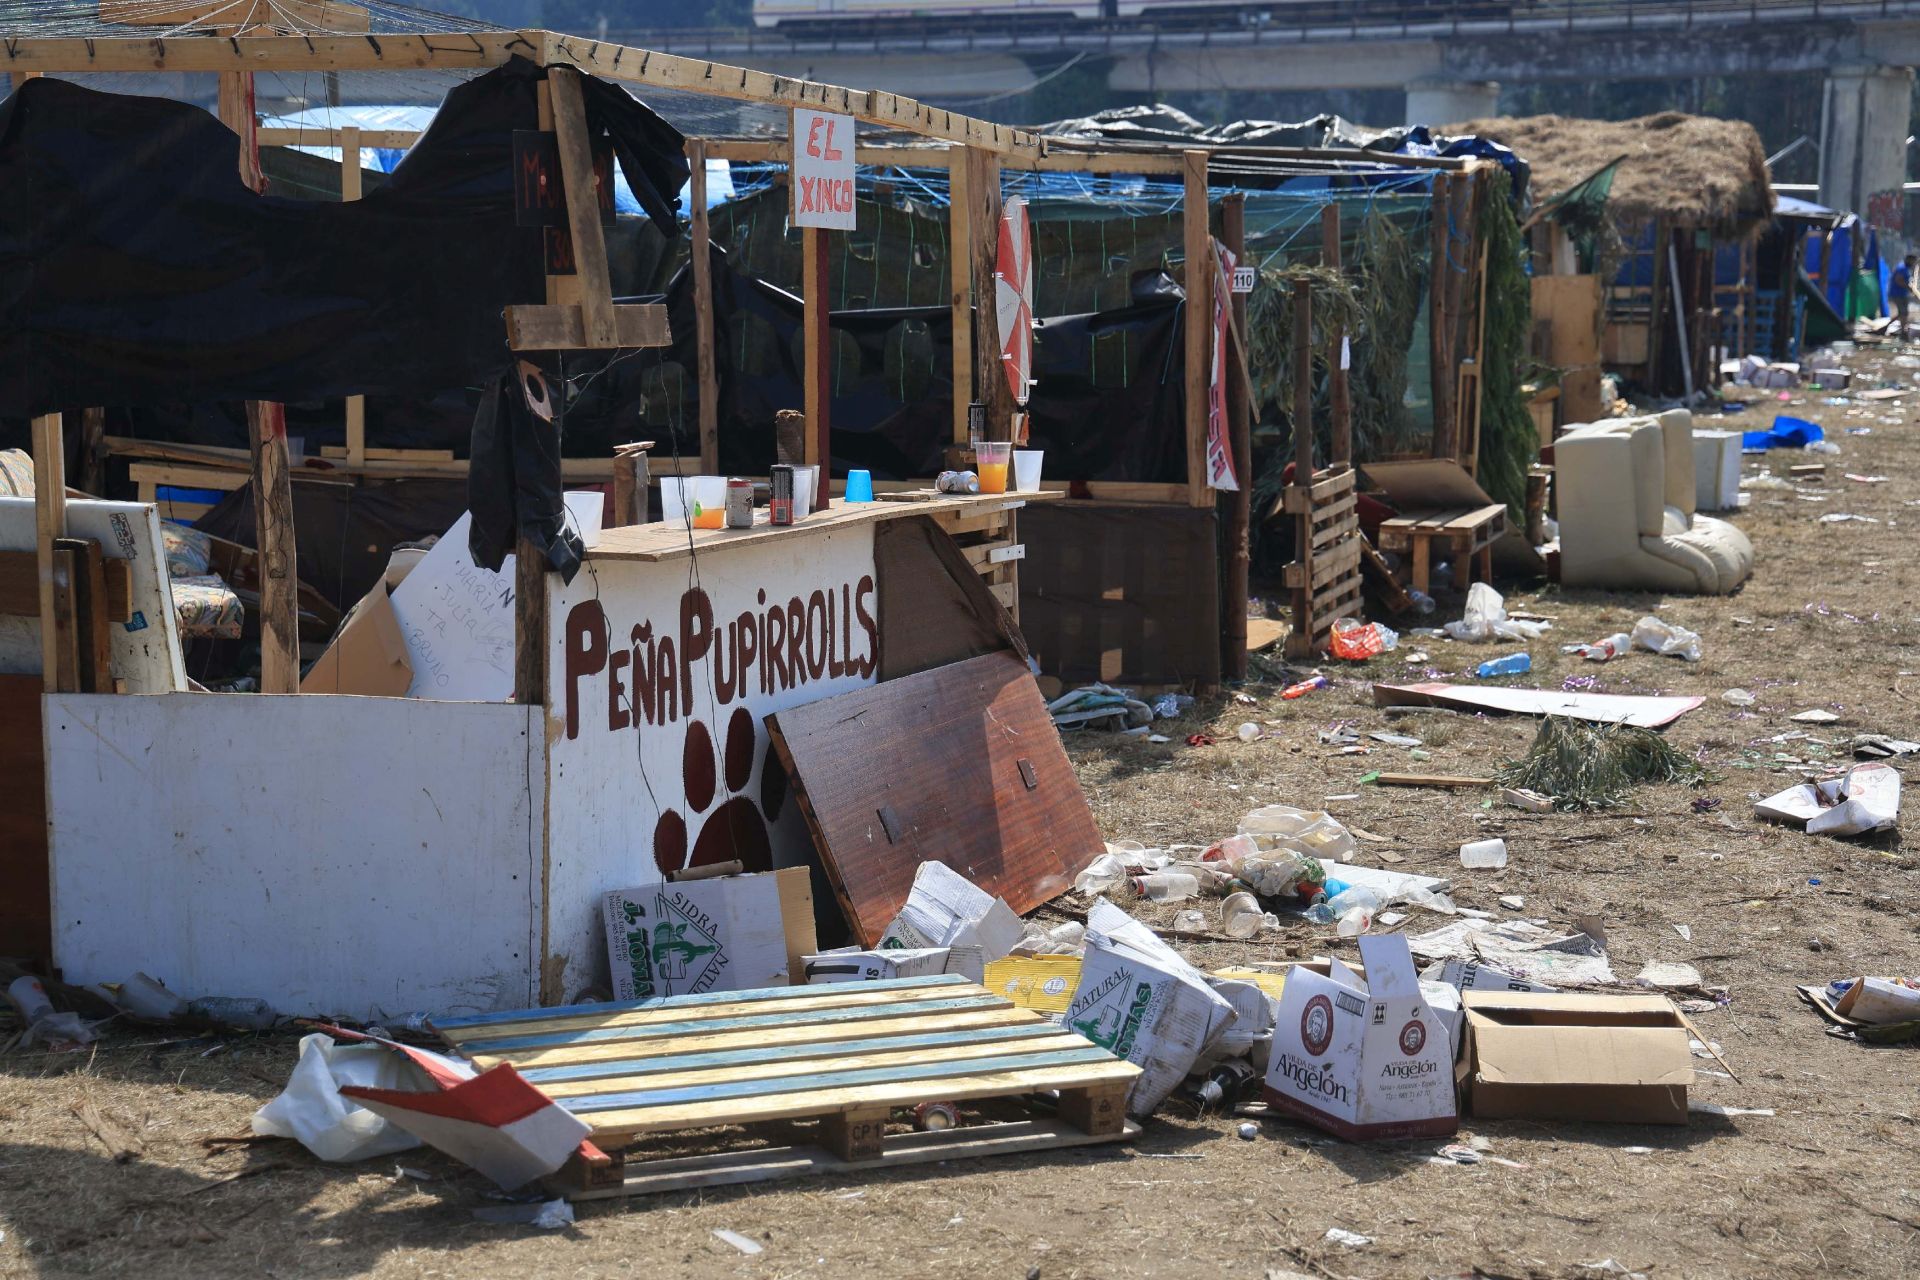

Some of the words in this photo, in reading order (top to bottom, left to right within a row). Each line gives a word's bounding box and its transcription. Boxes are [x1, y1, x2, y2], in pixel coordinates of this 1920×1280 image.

[806, 116, 842, 161] EL
[800, 175, 853, 214] XINCO
[1233, 274, 1252, 287] 110
[408, 628, 450, 688] BRUNO
[565, 599, 678, 740] PEÑA
[671, 891, 720, 938] SIDRA
[626, 927, 657, 1000] TOMA
[692, 952, 730, 995] NATU
[1070, 966, 1129, 1016] NATURAL
[1115, 982, 1152, 1060] OMAS
[1274, 1053, 1347, 1103] Angelón
[1381, 1059, 1438, 1079] Angelón
[852, 1124, 870, 1140] CP
